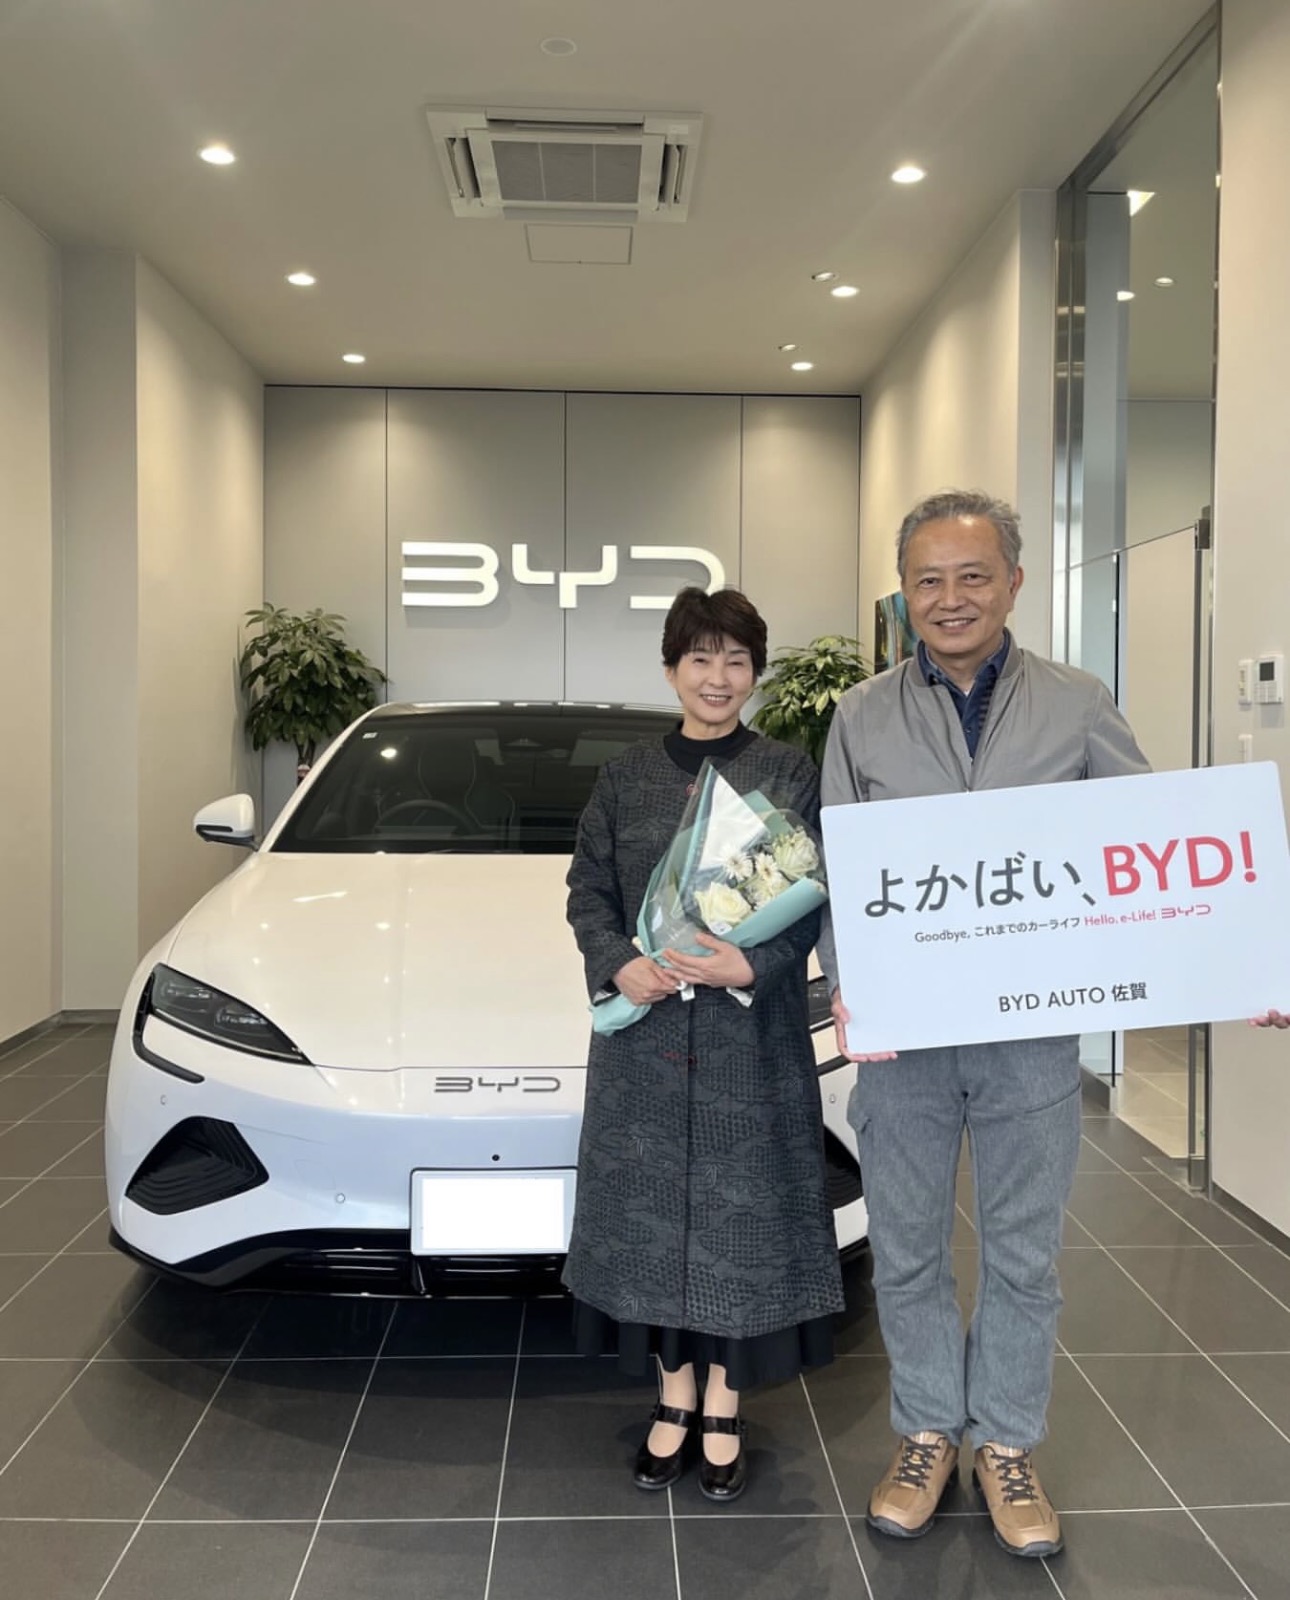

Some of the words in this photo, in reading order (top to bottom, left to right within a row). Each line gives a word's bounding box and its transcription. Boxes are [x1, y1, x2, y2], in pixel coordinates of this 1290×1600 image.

[402, 541, 725, 609] BYD
[915, 930, 971, 943] Goodbye,
[974, 917, 1081, 937] これまでのカーライフ
[1120, 909, 1157, 922] e-Life!
[1161, 904, 1212, 919] BYD
[999, 993, 1041, 1013] BYD
[1047, 987, 1106, 1008] AUTO
[1111, 982, 1148, 1003] 佐賀
[434, 1076, 561, 1093] BYD
